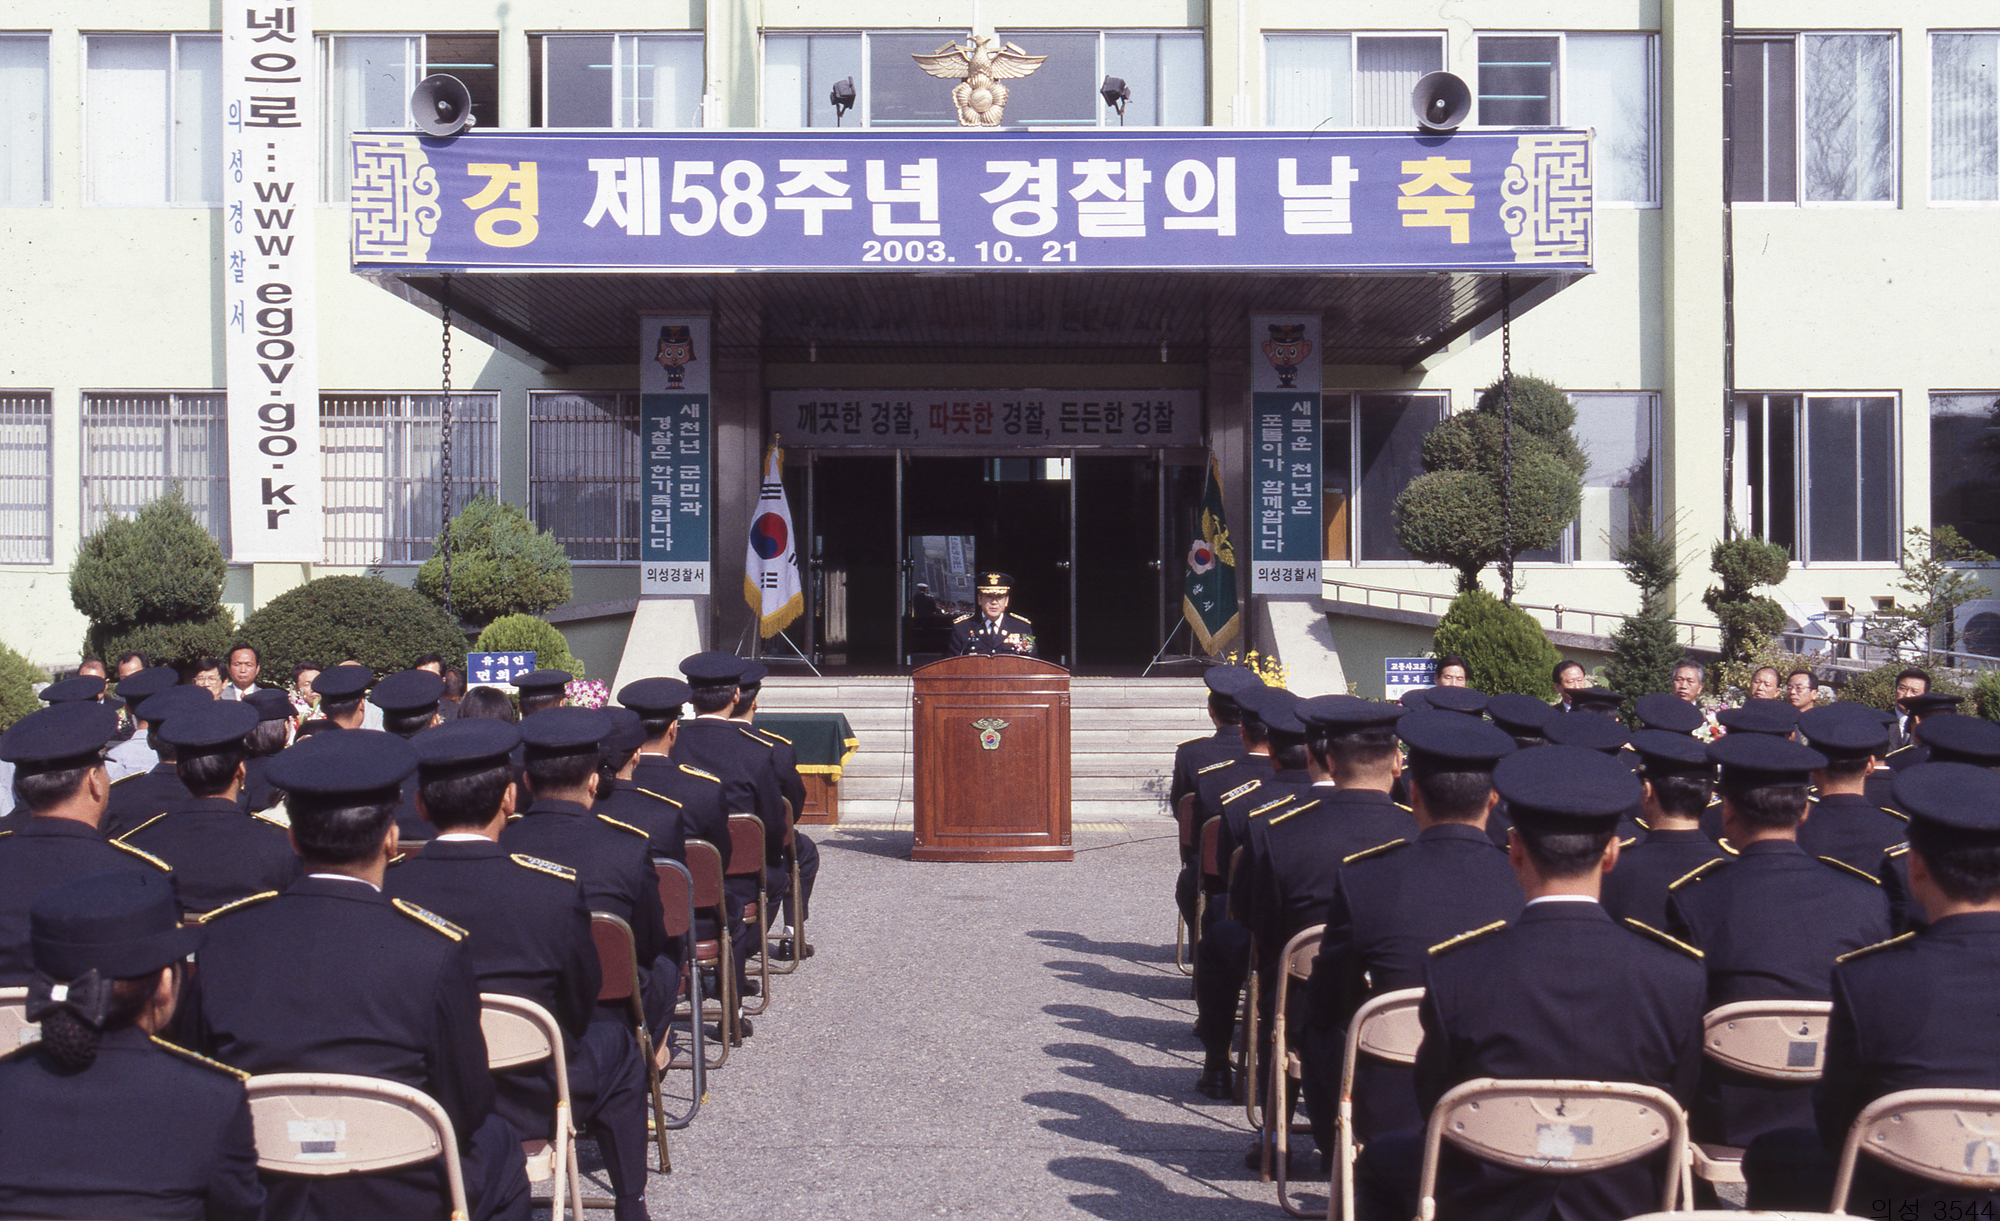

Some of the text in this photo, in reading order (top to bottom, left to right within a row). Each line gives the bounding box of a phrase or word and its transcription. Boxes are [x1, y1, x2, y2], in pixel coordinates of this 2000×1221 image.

[228, 99, 247, 334] 의성경찰서
[462, 155, 1476, 248] 경 제58주년 경찰의 날 축
[861, 240, 1078, 263] 2003. 10. 21
[797, 400, 1175, 440] 깨끗한 경찰, 따뜻한 경찰, 든든한 경찰
[1290, 401, 1313, 515] 새로운 천년은
[650, 416, 674, 552] 경찰은 한가족입니다
[1261, 480, 1285, 553] 함께합니다
[647, 567, 704, 582] 의성경찰서
[1258, 567, 1317, 582] 의성경찰서
[480, 655, 525, 666] 유치인
[1390, 674, 1436, 683] 교통지도
